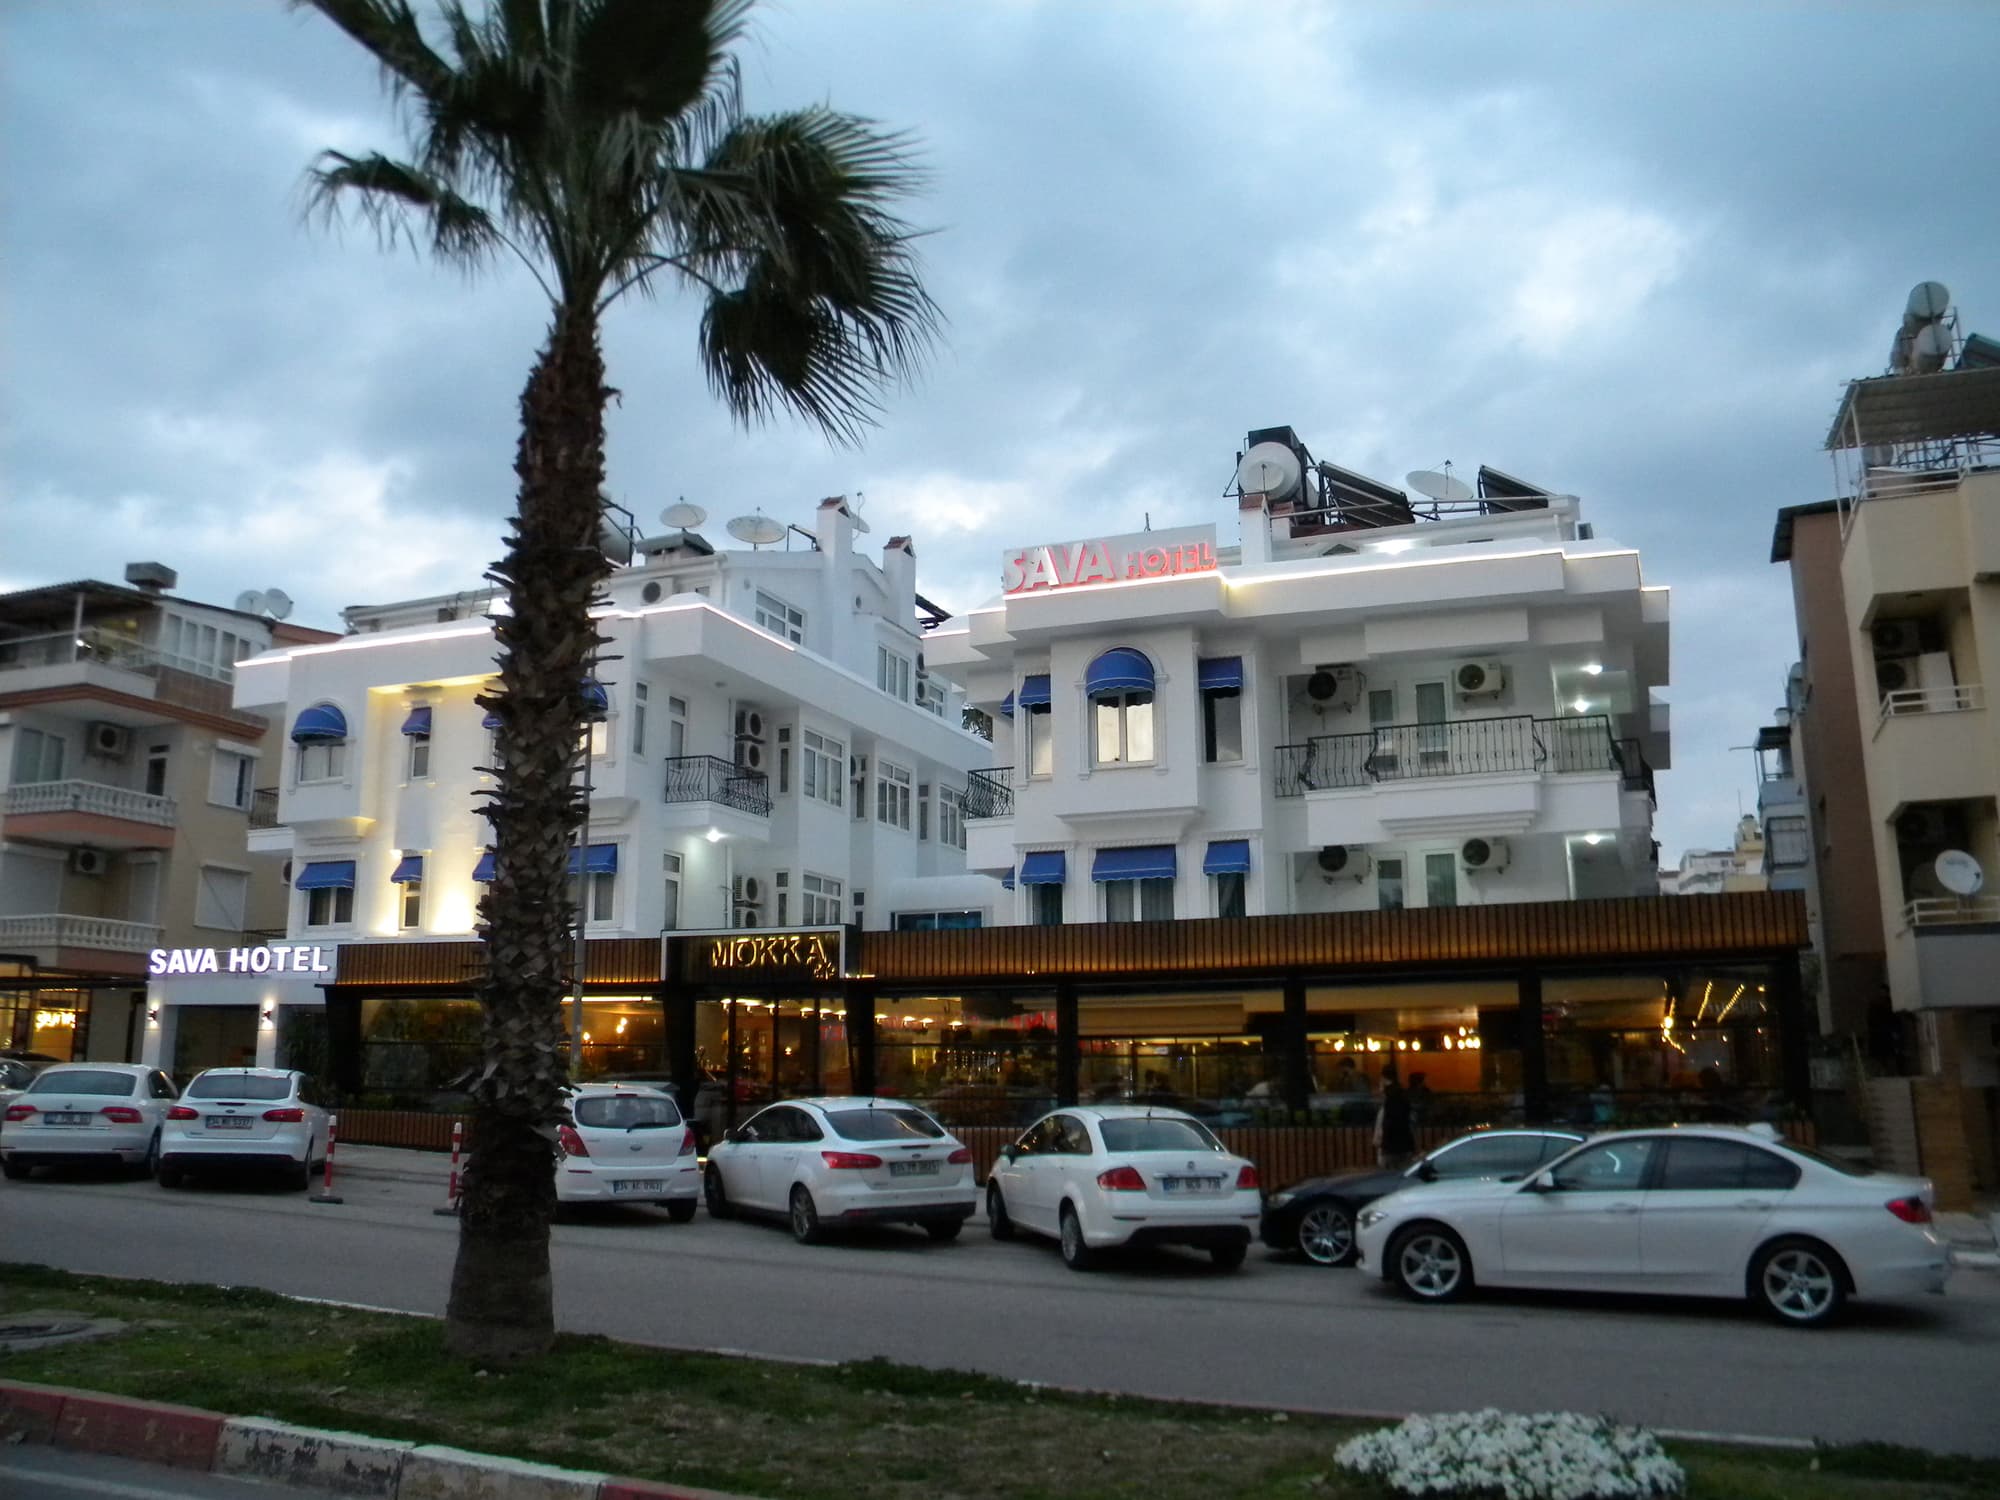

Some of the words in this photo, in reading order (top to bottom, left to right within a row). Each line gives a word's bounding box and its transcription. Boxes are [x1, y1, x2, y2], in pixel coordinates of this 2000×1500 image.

[1003, 541, 1119, 594] SAVA
[1122, 542, 1218, 579] HOTEL
[149, 948, 218, 975] SAVA
[229, 946, 329, 974] HOTEL
[711, 935, 827, 968] MOKKA
